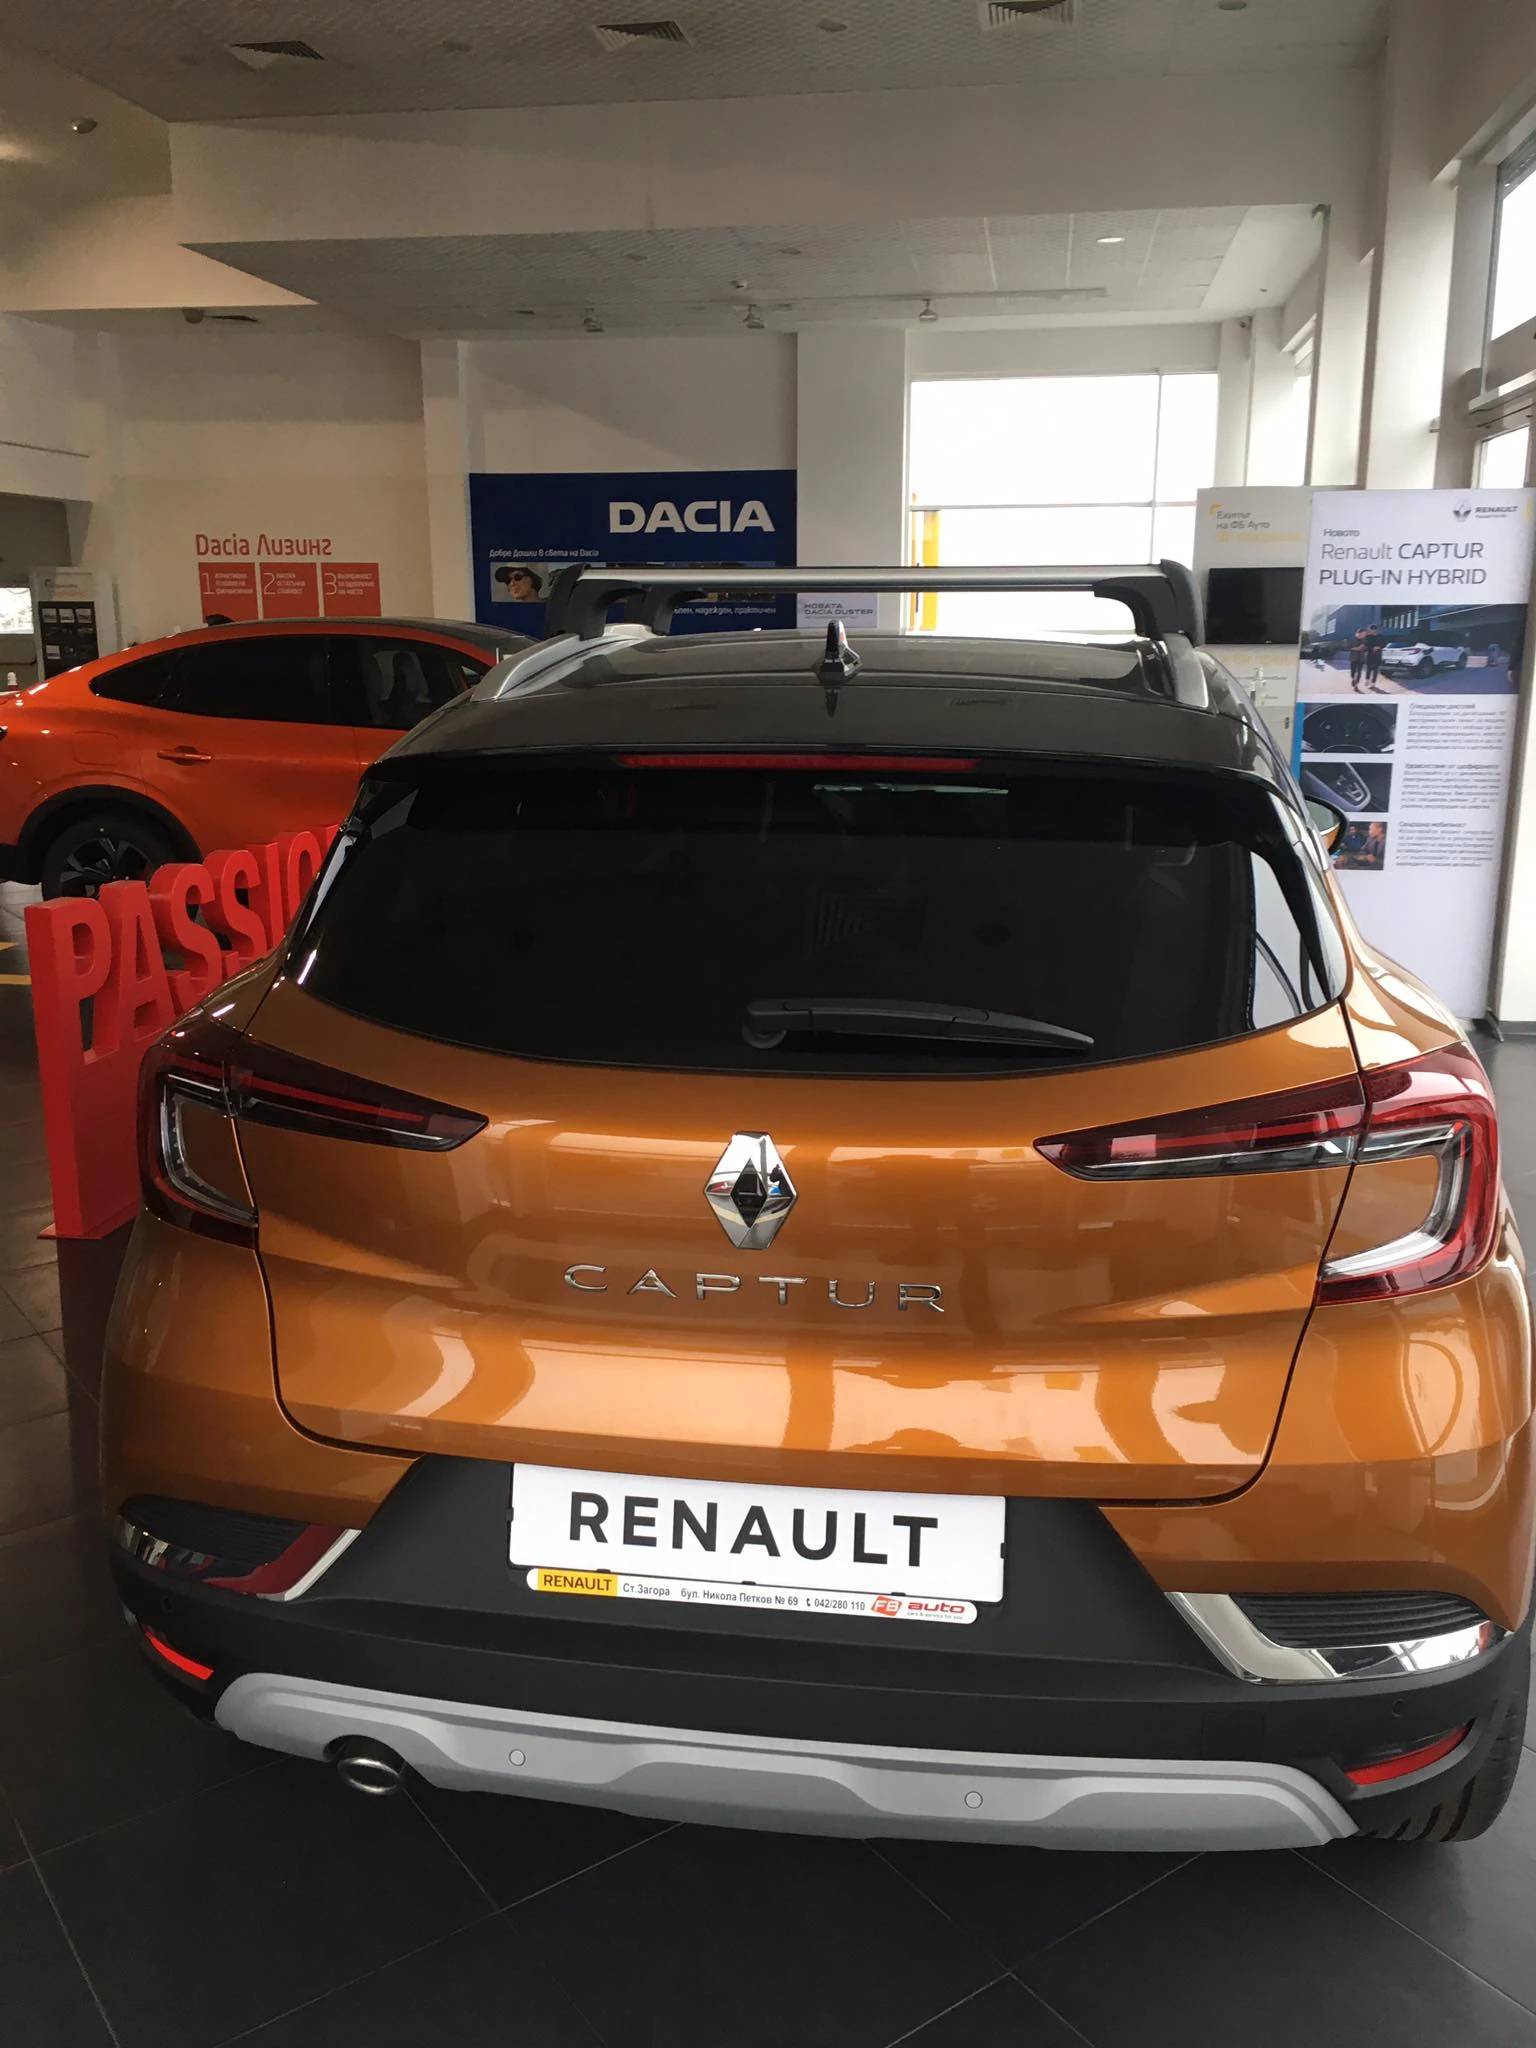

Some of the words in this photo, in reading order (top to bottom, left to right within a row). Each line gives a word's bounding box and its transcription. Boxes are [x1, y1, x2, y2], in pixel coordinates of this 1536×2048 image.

[609, 500, 776, 533] DACIA
[1247, 521, 1271, 531] Ауто
[195, 533, 250, 556] Dacia
[257, 533, 332, 556] Лизинг
[1320, 543, 1393, 560] Renault
[1399, 543, 1484, 560] CAPTUR
[202, 573, 215, 595] 1
[263, 572, 276, 595] 2
[324, 573, 337, 596] 3
[1319, 569, 1401, 585] PLUG-IN
[1407, 568, 1487, 585] HYBRID
[25, 825, 338, 1065] PASSIO
[564, 1264, 945, 1313] CAPTUR
[569, 1491, 939, 1567] RENAULT
[543, 1574, 613, 1592] RENAULT
[622, 1583, 671, 1597] Ст.Загора
[681, 1587, 700, 1599] бул.
[703, 1590, 737, 1601] Никола
[740, 1593, 773, 1605] Петков
[774, 1596, 785, 1605] №
[787, 1596, 799, 1606] 69
[814, 1598, 848, 1610] 042/280
[851, 1600, 866, 1611] 110
[908, 1602, 965, 1614] auto
